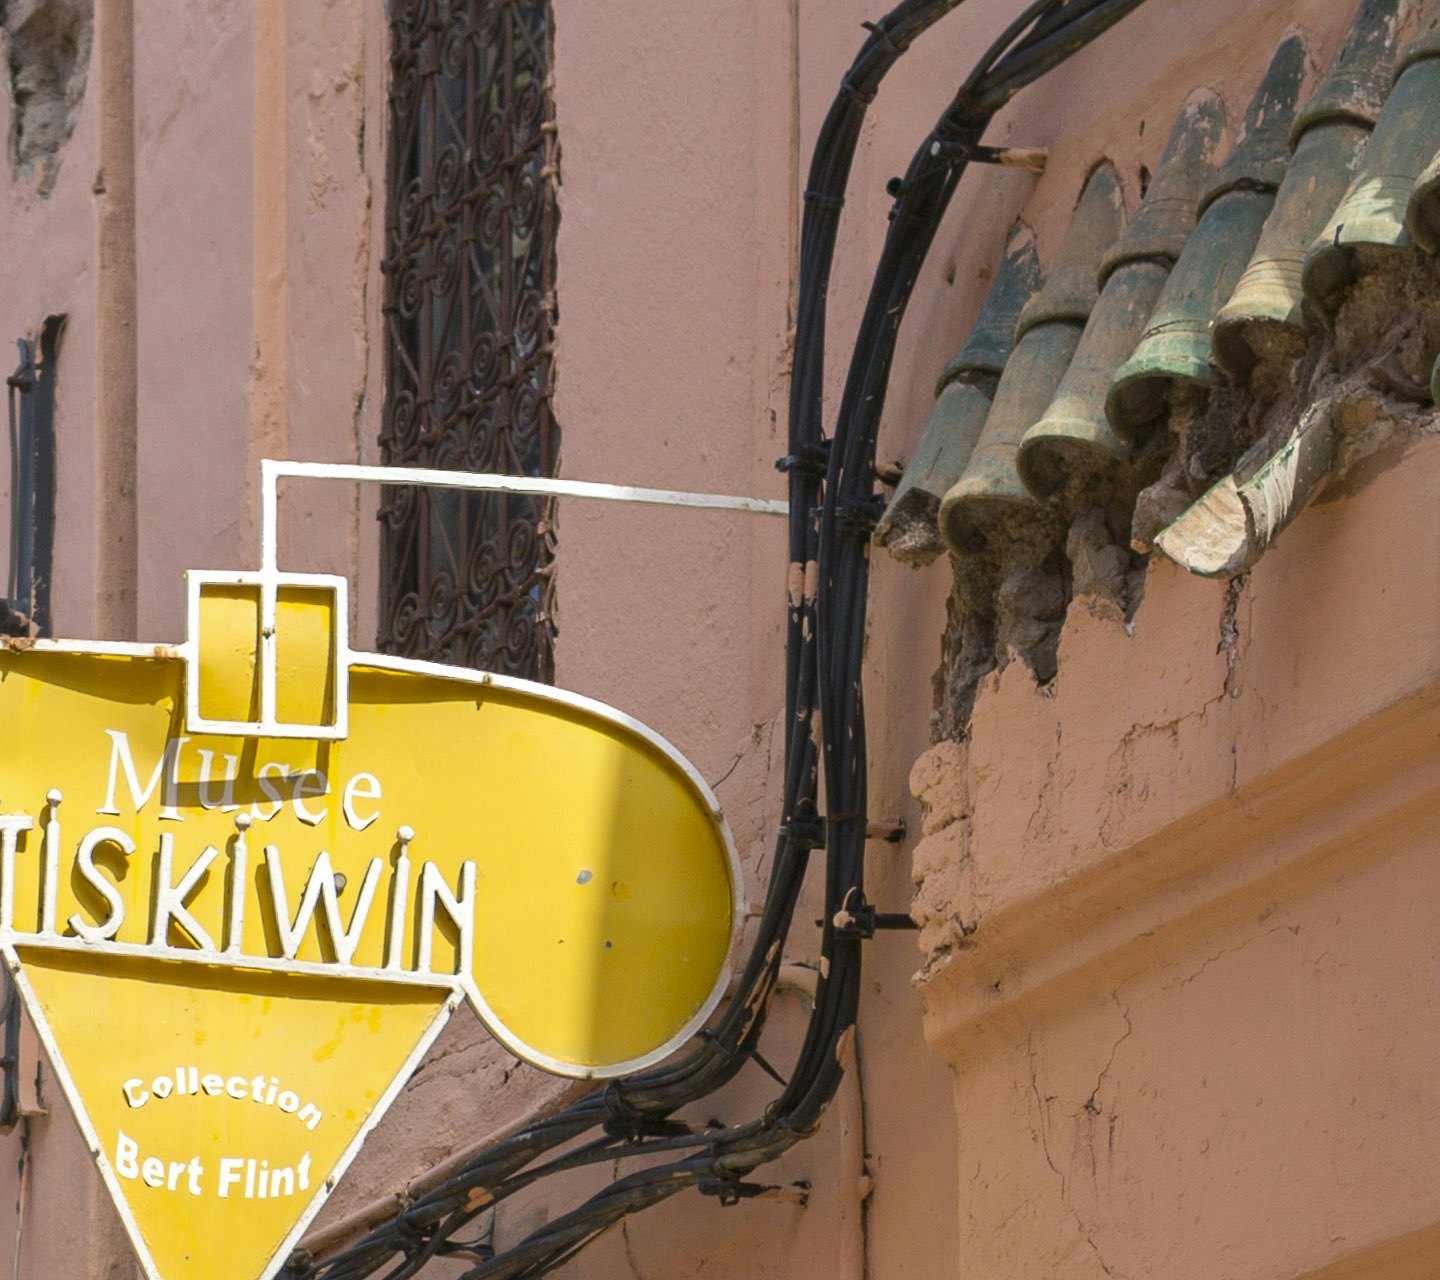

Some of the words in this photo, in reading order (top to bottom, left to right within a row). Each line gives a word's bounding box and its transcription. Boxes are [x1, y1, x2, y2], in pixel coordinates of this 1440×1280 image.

[122, 1066, 323, 1131] Collection
[115, 1129, 204, 1196] Bert
[218, 1151, 312, 1199] Flint
